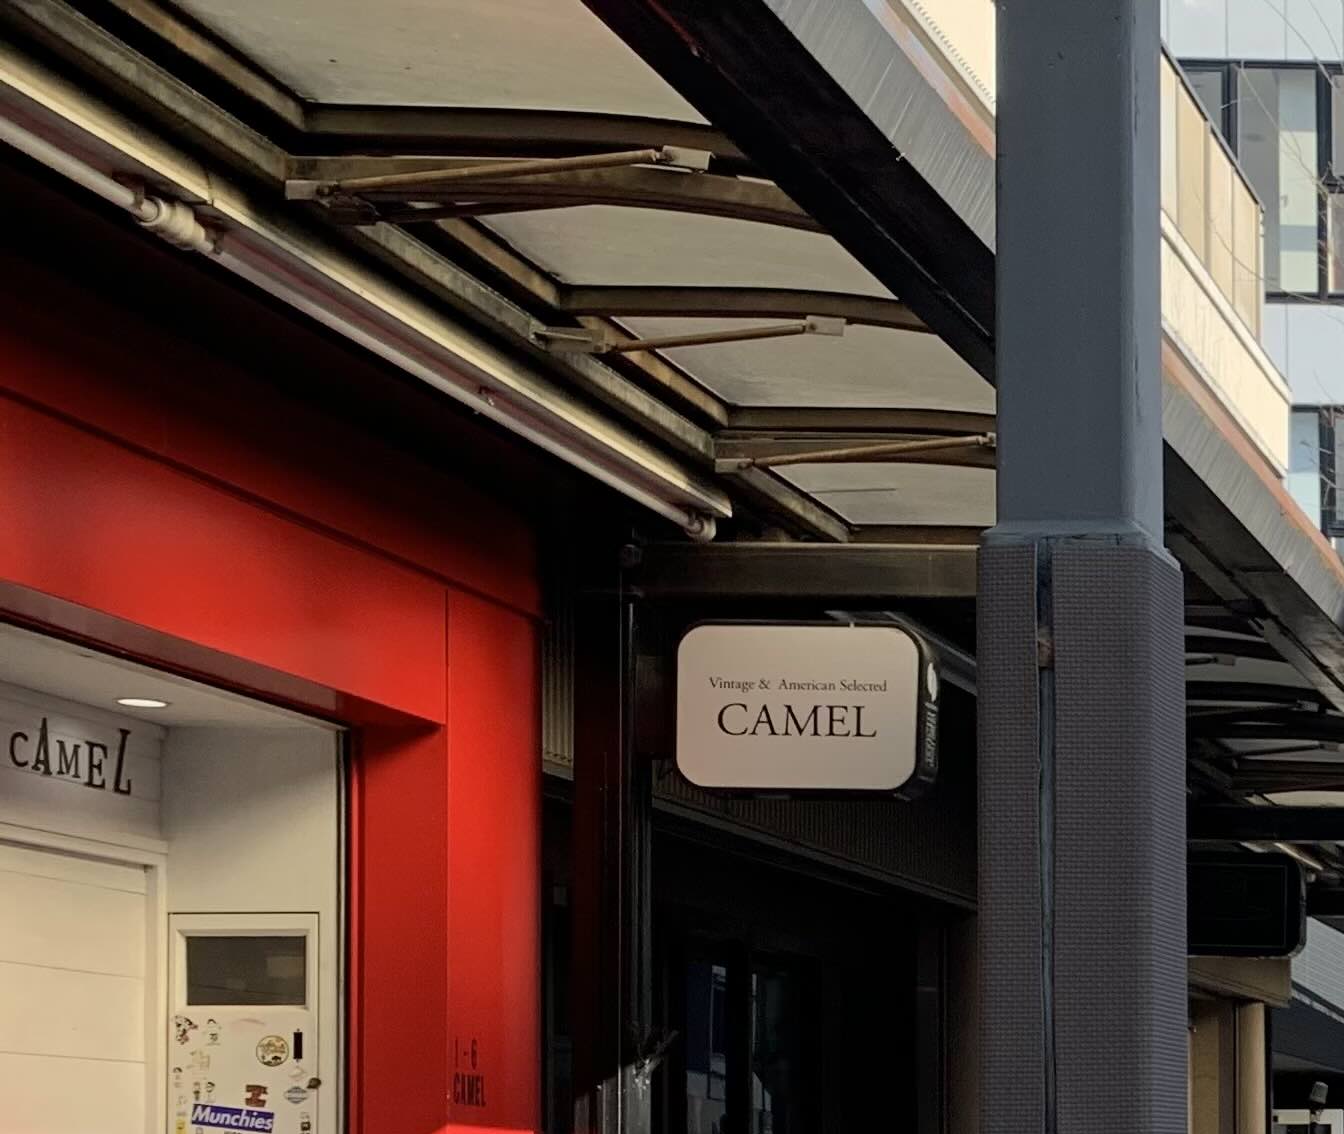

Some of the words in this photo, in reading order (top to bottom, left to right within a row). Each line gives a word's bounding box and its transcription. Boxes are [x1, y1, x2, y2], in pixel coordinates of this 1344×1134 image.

[709, 677, 755, 693] Vintage
[758, 678, 771, 690] &
[778, 679, 836, 692] American
[840, 679, 887, 693] Selected
[717, 703, 877, 738] CAMEL
[9, 717, 131, 796] CAMEL
[192, 1105, 273, 1130] Munchies
